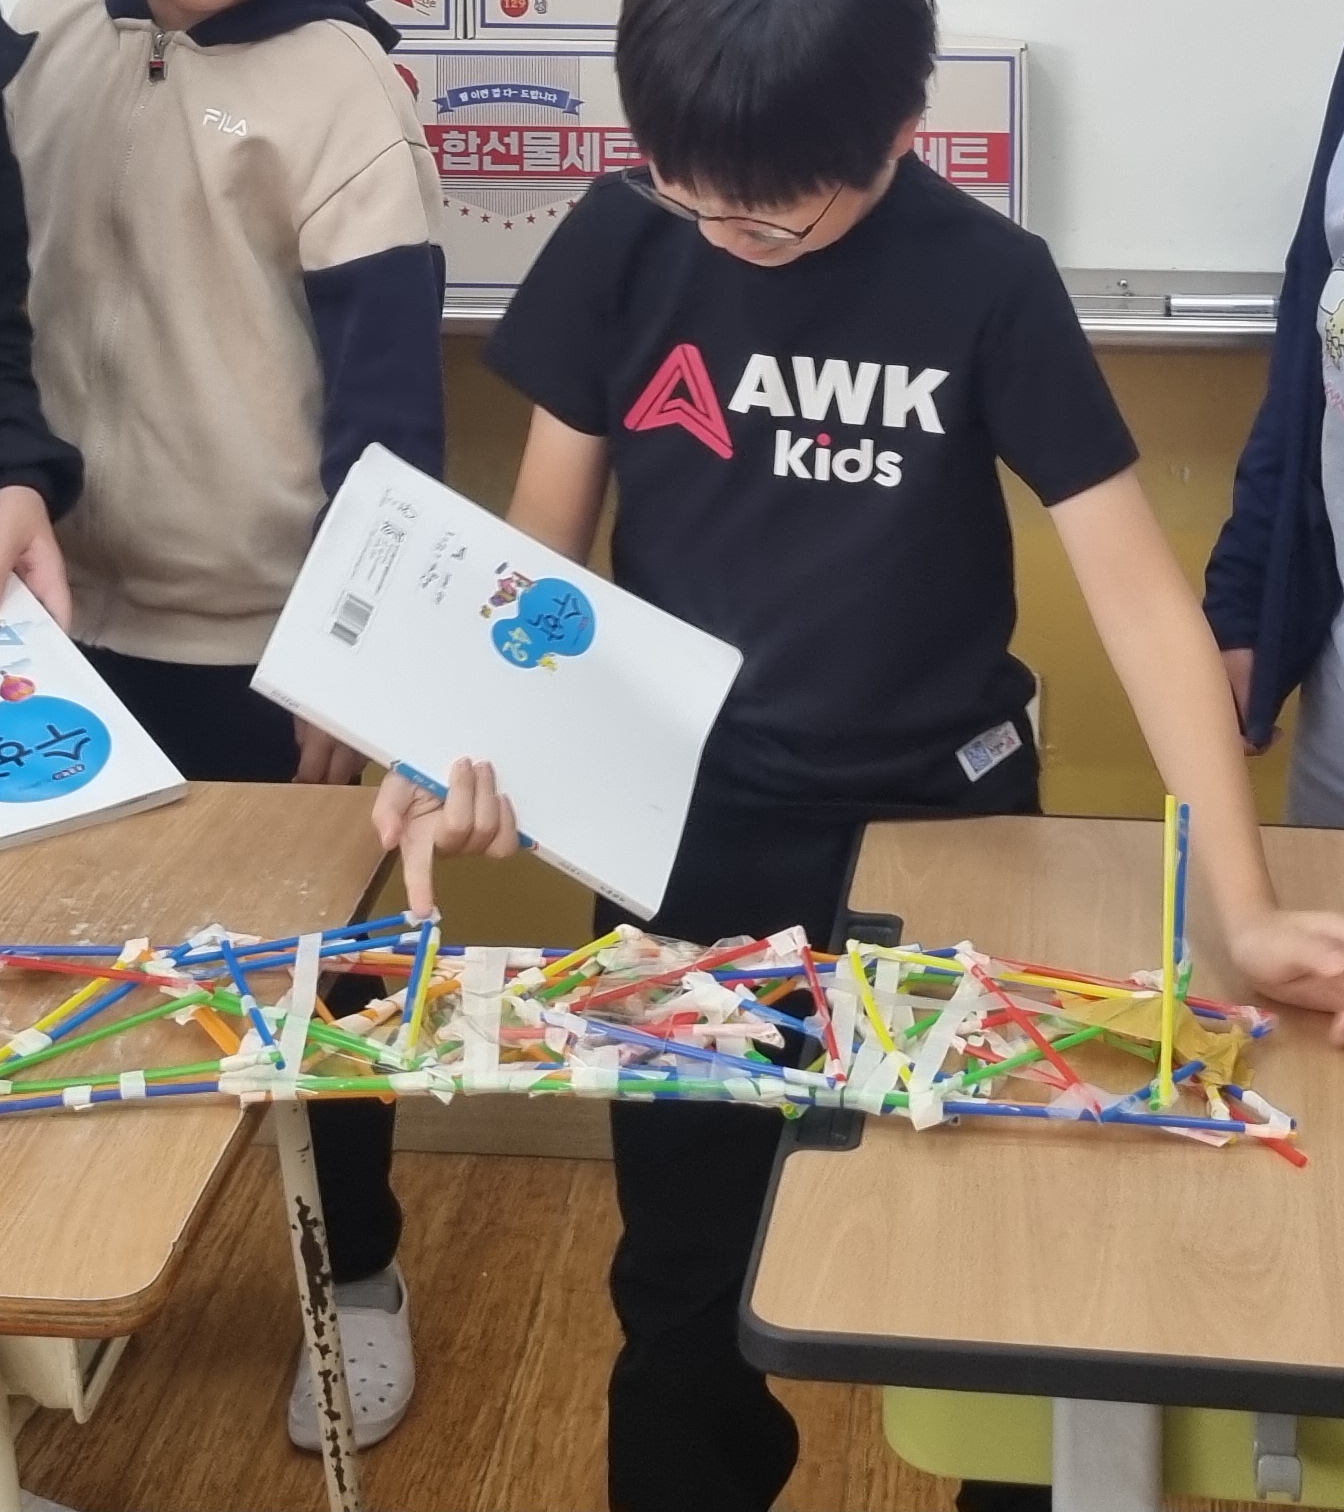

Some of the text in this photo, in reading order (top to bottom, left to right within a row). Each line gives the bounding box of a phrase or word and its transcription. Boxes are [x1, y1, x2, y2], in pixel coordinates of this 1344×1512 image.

[520, 89, 558, 104] 드립니다
[202, 107, 248, 137] FILA
[727, 353, 951, 435] AWK
[772, 429, 904, 488] Kids
